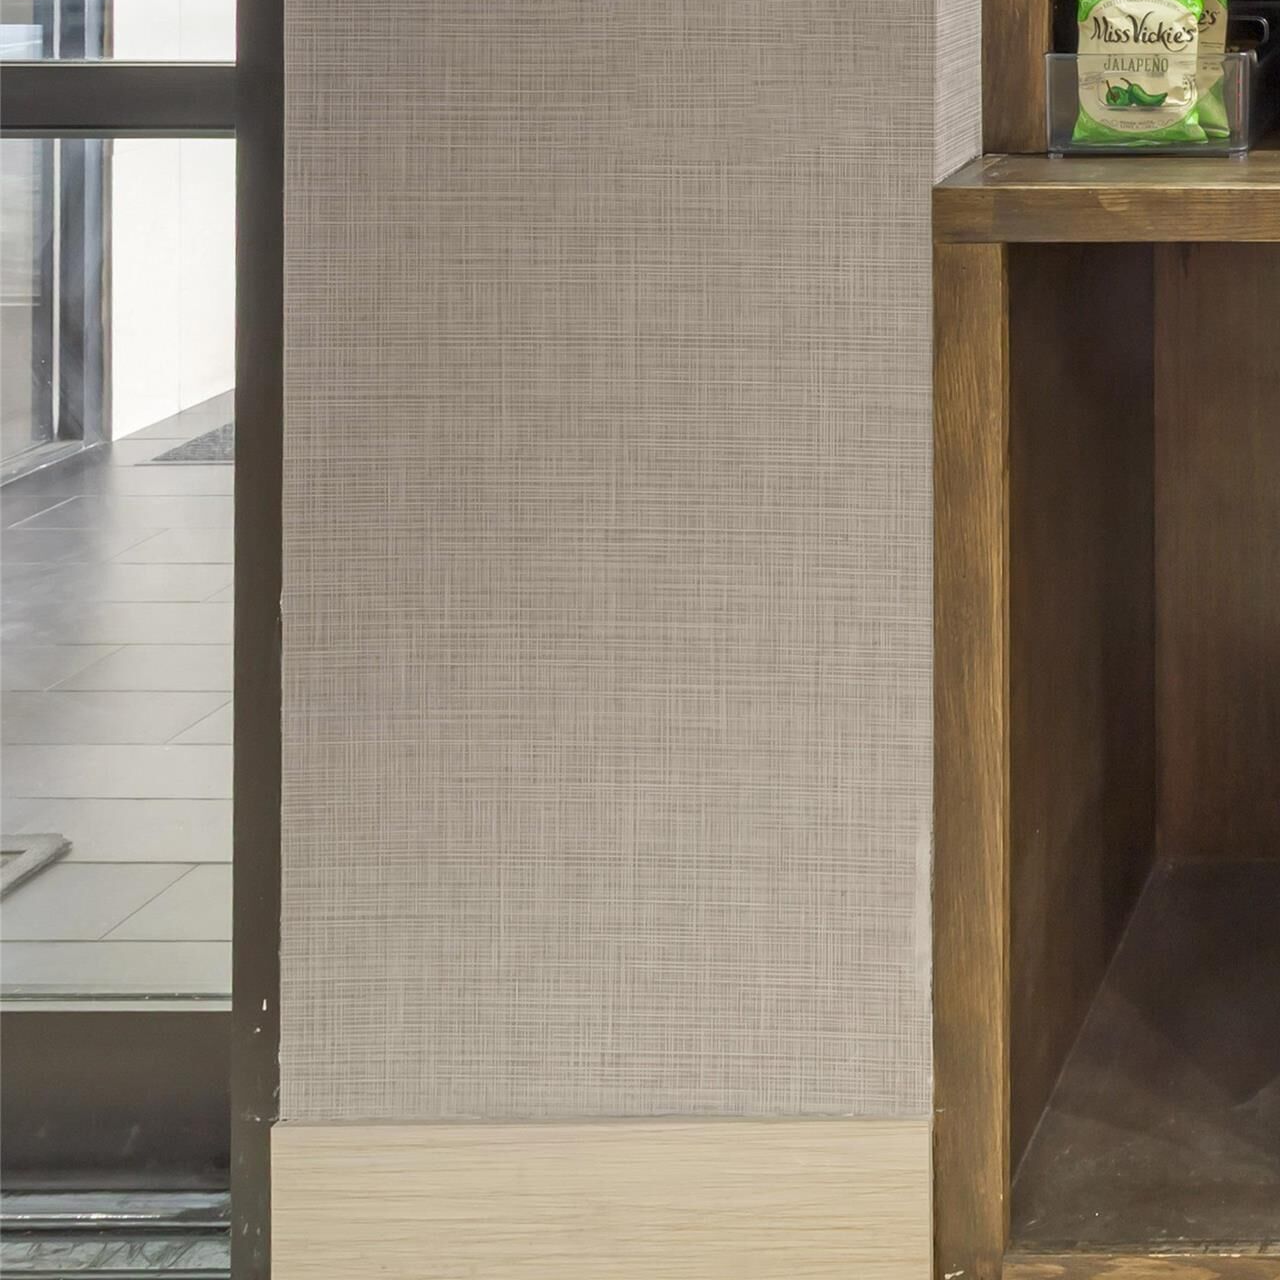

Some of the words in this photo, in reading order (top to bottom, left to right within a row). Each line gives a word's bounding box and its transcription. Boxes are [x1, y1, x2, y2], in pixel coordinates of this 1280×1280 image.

[1090, 16, 1130, 43] Miss
[1128, 11, 1197, 52] Vickie's
[1103, 54, 1169, 73] JALAPEÑO
